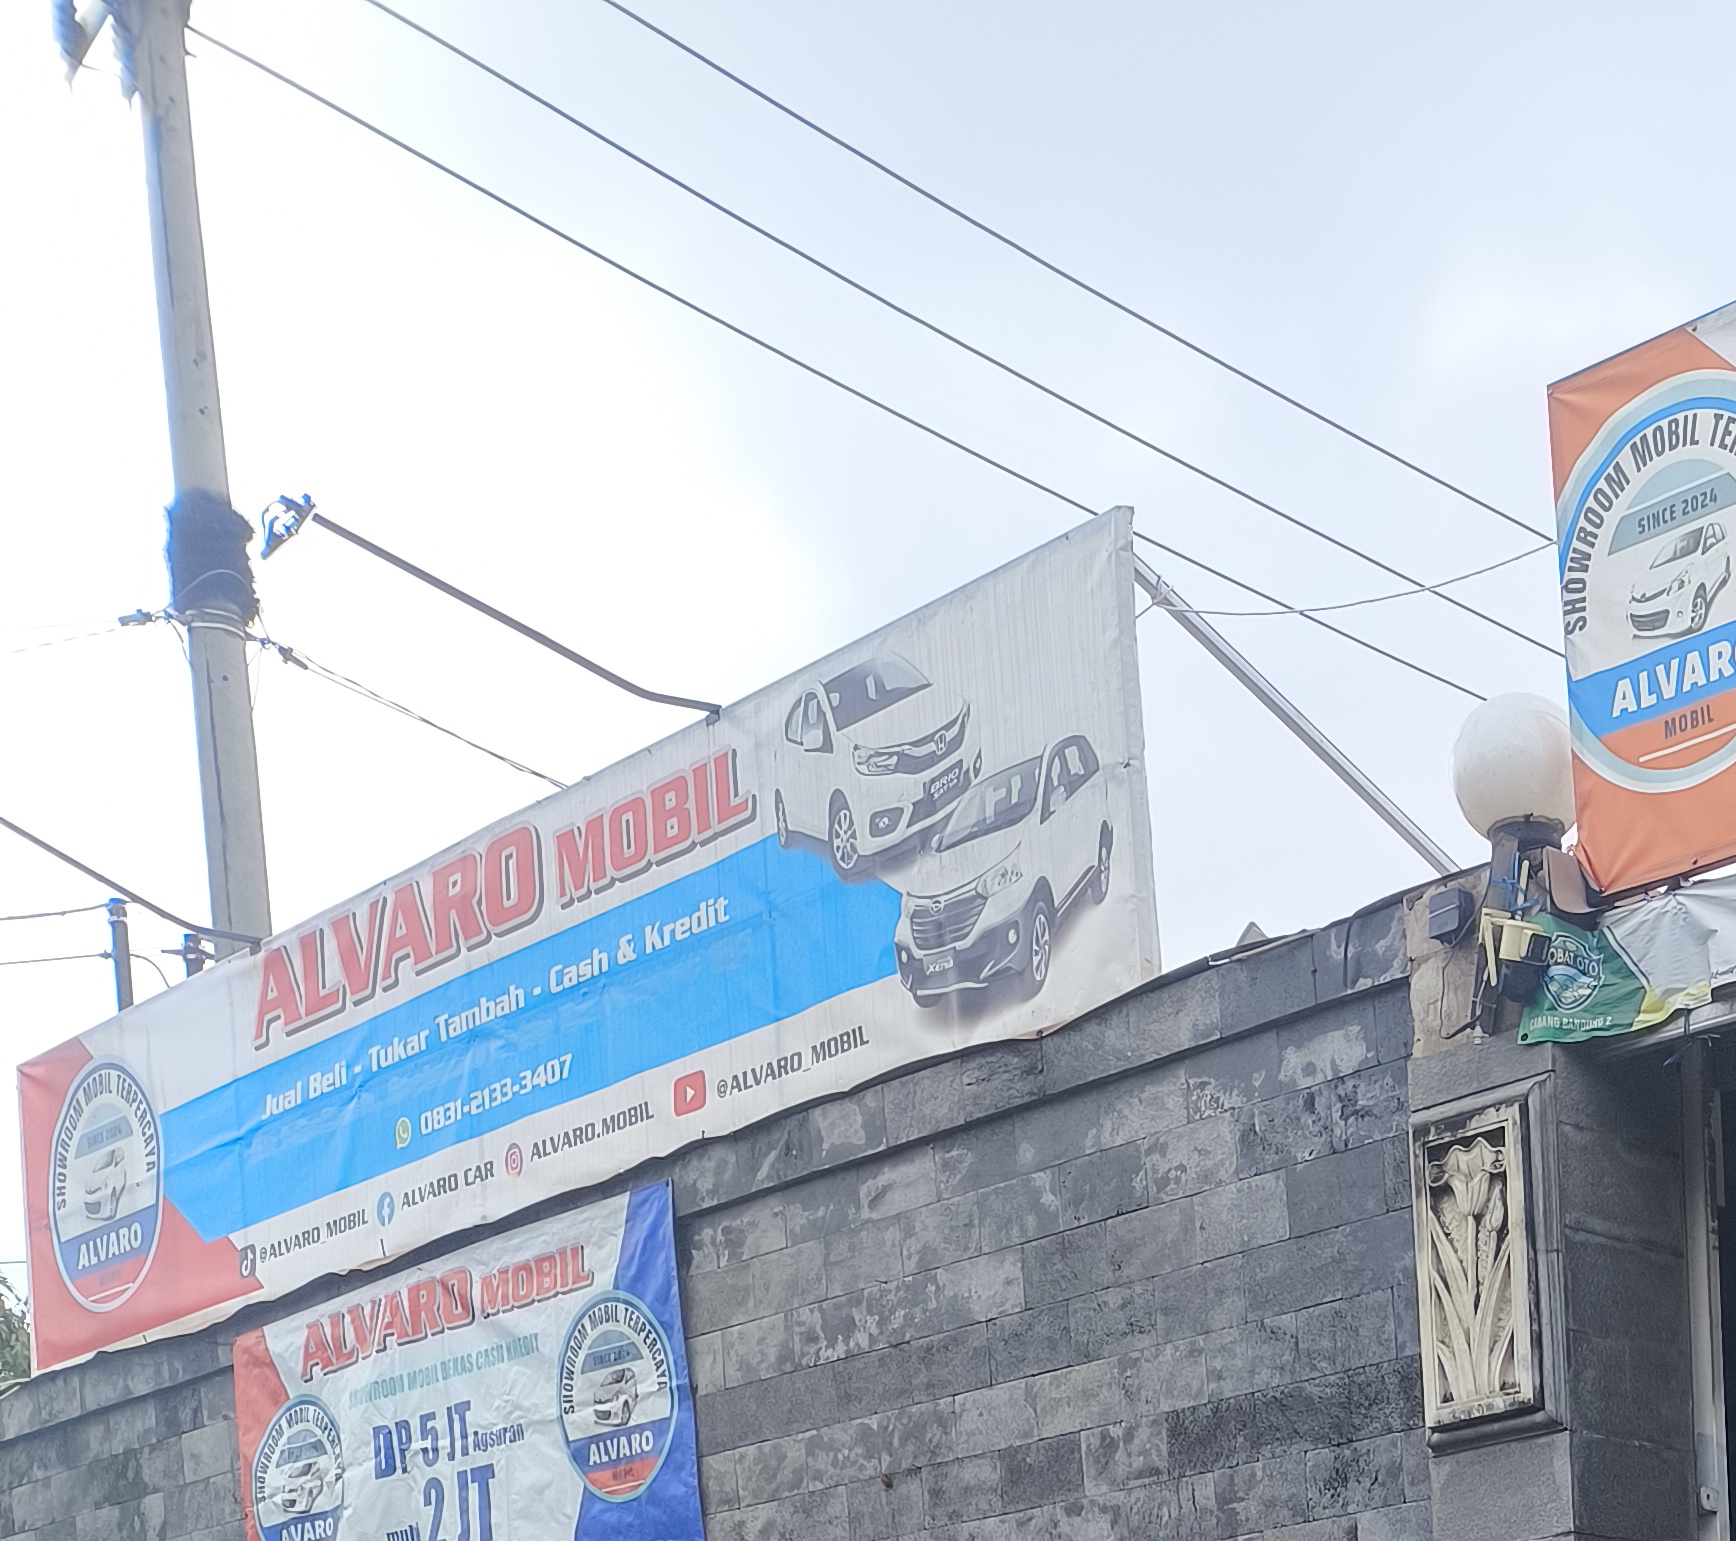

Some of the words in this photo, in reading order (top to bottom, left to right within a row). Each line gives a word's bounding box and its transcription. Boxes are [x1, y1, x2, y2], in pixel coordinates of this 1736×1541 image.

[1564, 461, 1631, 636] SHOWROOM
[1629, 412, 1700, 474] MOBIL
[1637, 507, 1676, 536] SINCE
[1682, 491, 1718, 518] 2024
[1663, 703, 1714, 740] MOBIL
[252, 821, 545, 1050] ALVARO
[555, 746, 757, 910] MOBIL
[1549, 948, 1575, 965] OBAT
[1577, 957, 1598, 975] OTO
[260, 1089, 302, 1121] Jual
[308, 1064, 348, 1101] Beli
[368, 1029, 428, 1073] Tukar
[434, 986, 526, 1044] Tambah
[549, 950, 608, 994] Cash
[617, 934, 637, 963] &
[643, 896, 731, 955] Kredit
[83, 1071, 113, 1104] MOBIL
[116, 1073, 156, 1173] TERPERCAYA
[419, 1055, 574, 1137] 0831-2133-3407
[259, 1208, 370, 1265] @ALVARO_MOBIL
[401, 1174, 459, 1210] ALVARO
[464, 1160, 496, 1187] CAR
[530, 1102, 655, 1163] ALVARO.MOBIL
[716, 1025, 870, 1099] @ALVARO_MOBIL
[77, 1222, 142, 1270] ALVARO
[300, 1266, 474, 1383] ALVARO
[480, 1244, 594, 1318] MOBIL
[587, 1303, 621, 1330] MOBIL
[623, 1306, 668, 1390] TERPERCAYA
[372, 1419, 412, 1480] DP
[419, 1411, 439, 1467] 5
[446, 1400, 471, 1461] JT
[588, 1430, 654, 1466] ALVARO
